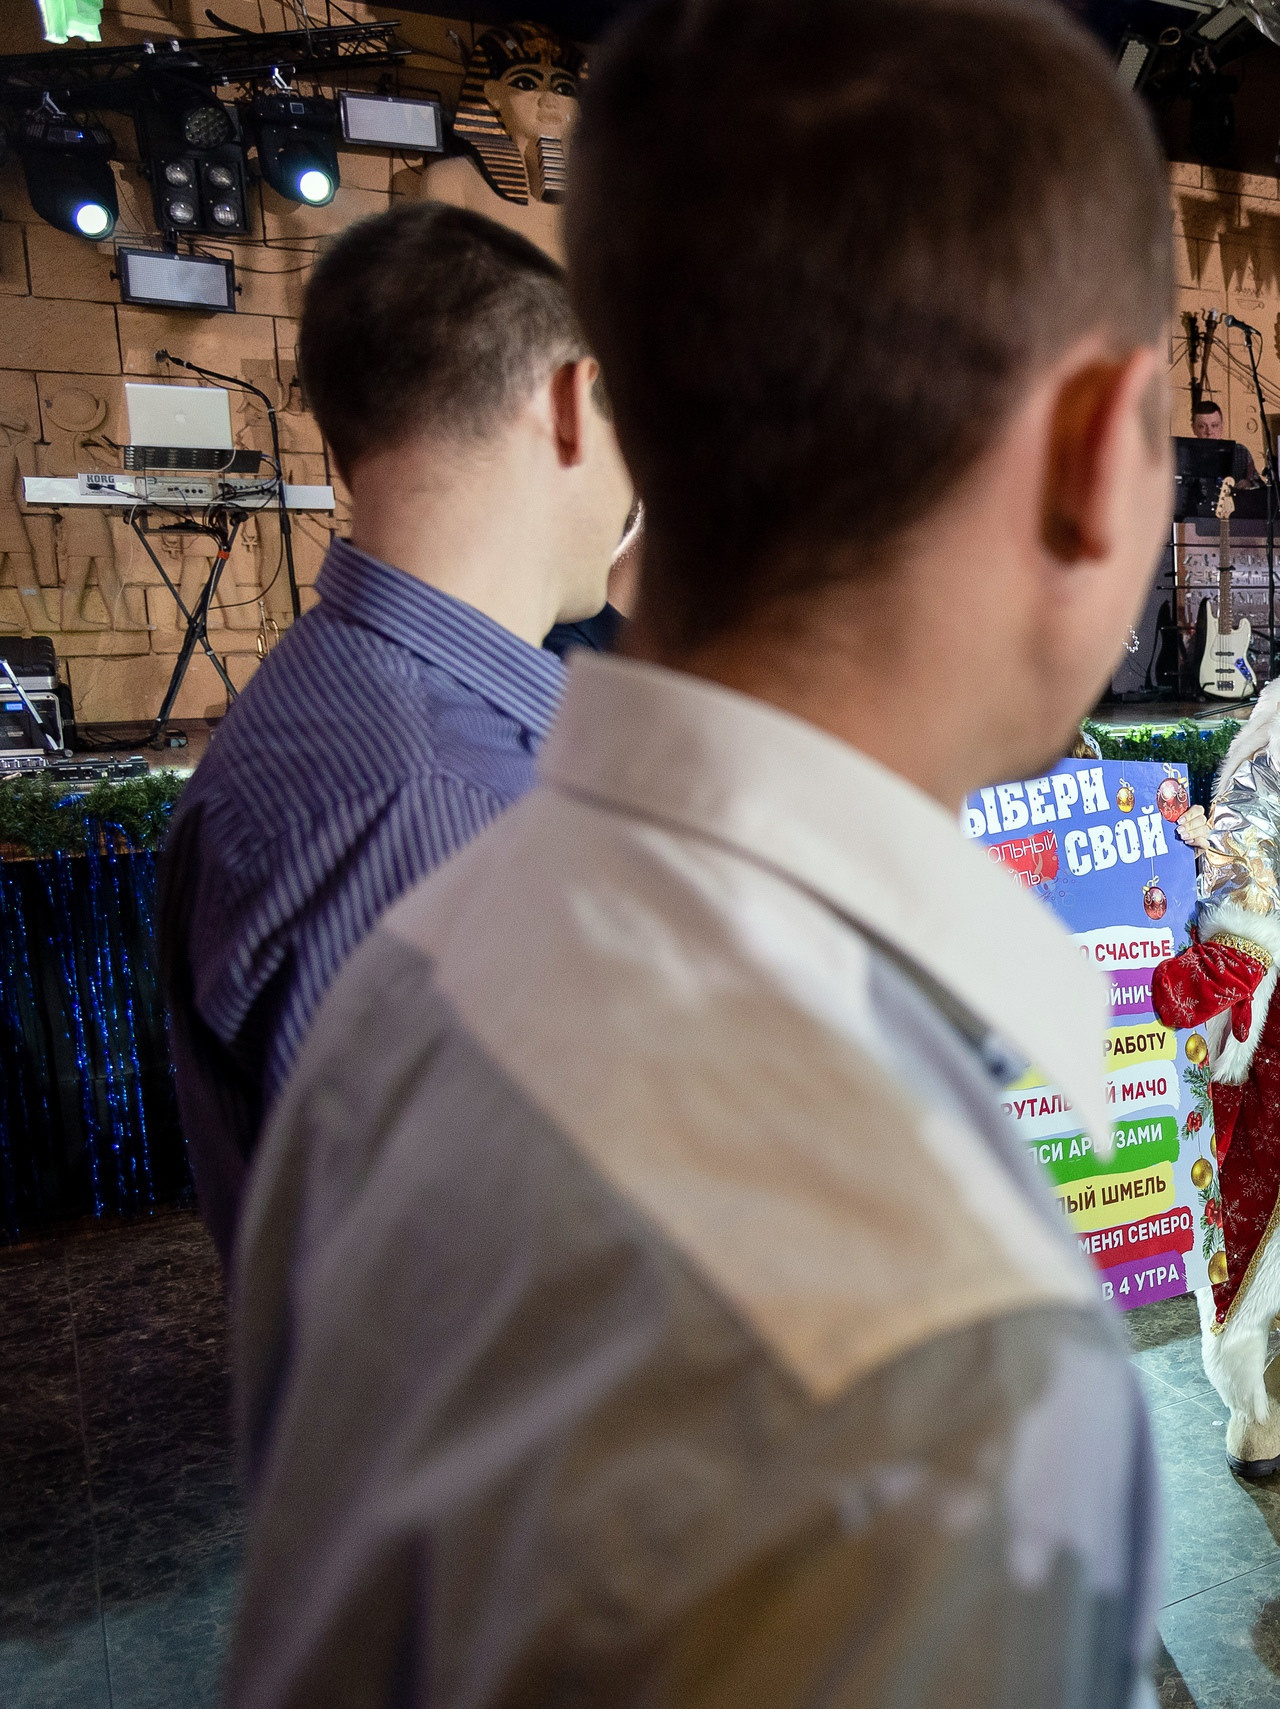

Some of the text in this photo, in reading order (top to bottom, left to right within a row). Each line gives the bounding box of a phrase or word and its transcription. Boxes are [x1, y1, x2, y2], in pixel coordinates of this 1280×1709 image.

[87, 475, 114, 483] KORG
[960, 767, 1110, 839] ЫБЕРИ
[1064, 805, 1169, 876] СВОЙ
[1095, 940, 1171, 962] СЧАСТЬЕ
[1103, 1032, 1166, 1057] РАБОТУ
[1000, 1077, 1168, 1120] РУТАЛЬЙ МАЧО
[1068, 1123, 1163, 1158] АРУЗАМИ
[1101, 1176, 1167, 1206] ШМЕЛЬ
[1078, 1212, 1190, 1255] МЕНЯ СЕМЕРО
[1101, 1263, 1180, 1301] В 4 УТРА
